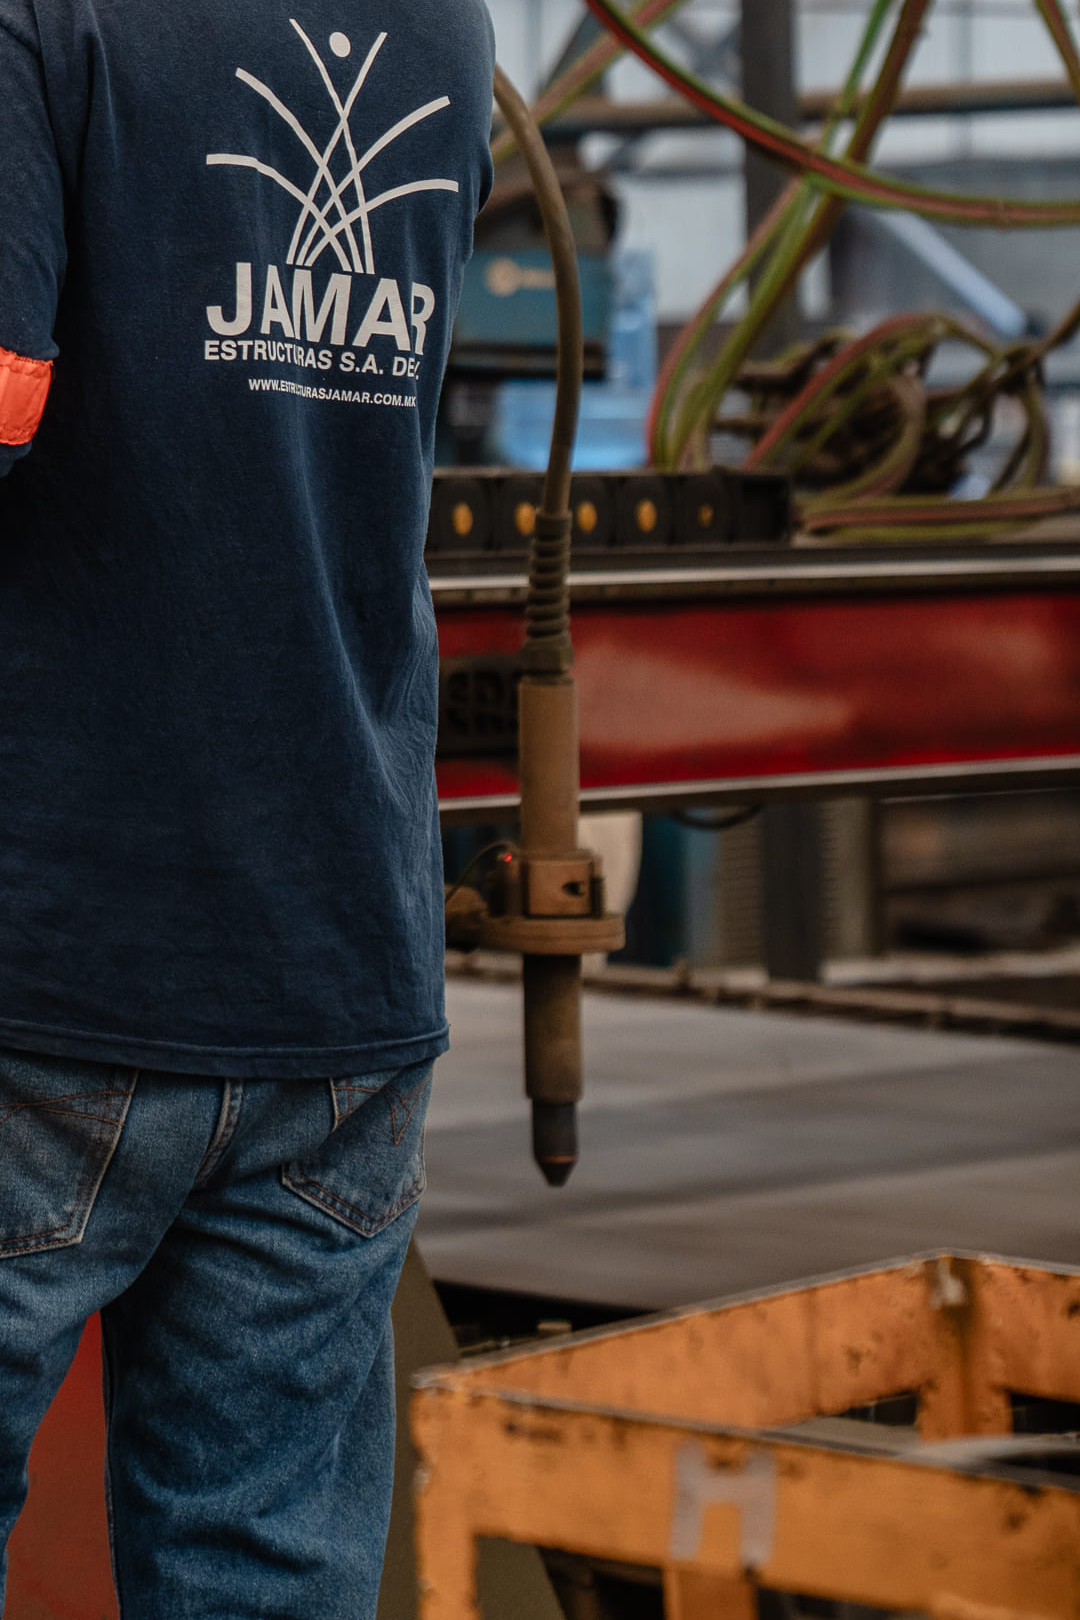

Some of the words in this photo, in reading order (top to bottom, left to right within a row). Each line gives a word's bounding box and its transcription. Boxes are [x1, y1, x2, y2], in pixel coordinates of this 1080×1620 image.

[206, 261, 435, 356] JAMAR
[339, 351, 384, 375] S.A.
[392, 356, 415, 378] DE
